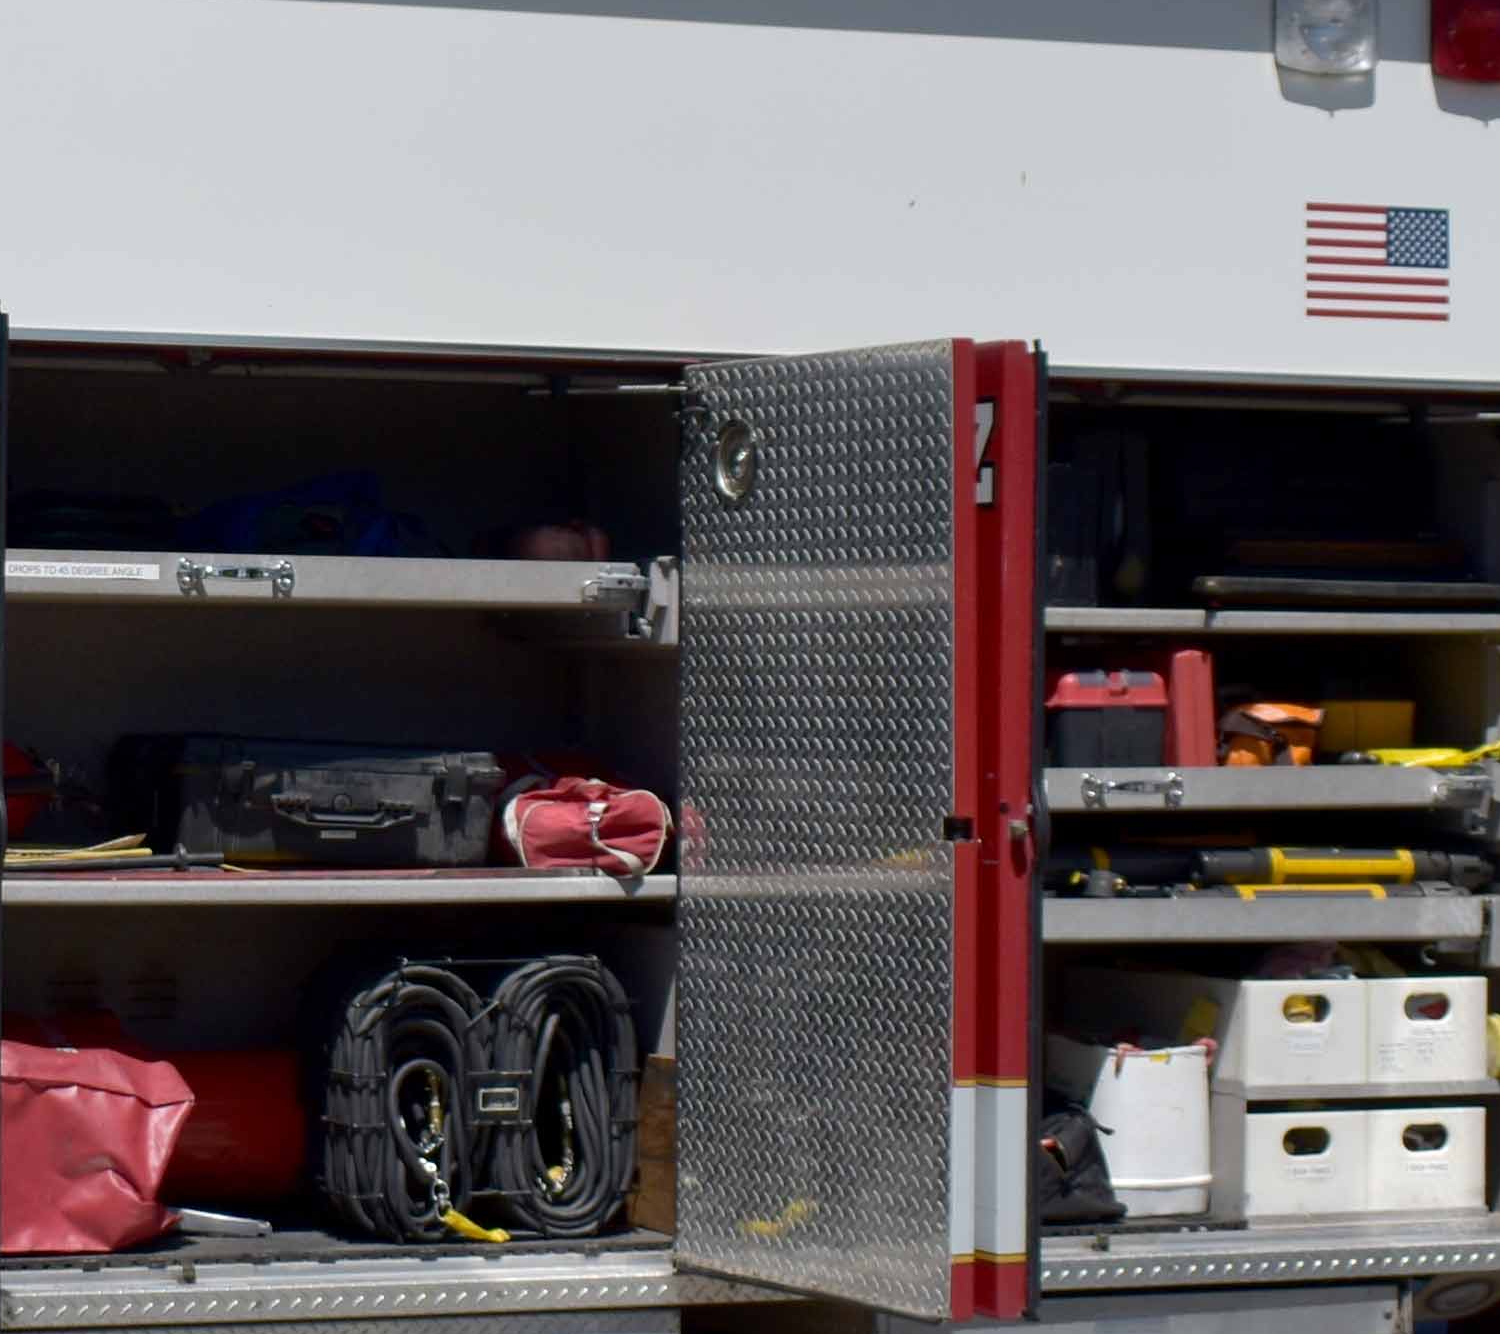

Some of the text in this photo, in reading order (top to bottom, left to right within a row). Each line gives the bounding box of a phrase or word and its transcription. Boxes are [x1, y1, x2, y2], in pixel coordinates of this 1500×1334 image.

[7, 564, 41, 575] DROPS
[43, 565, 57, 575] TO
[71, 565, 109, 576] DEGREE
[111, 566, 144, 577] ANGLE
